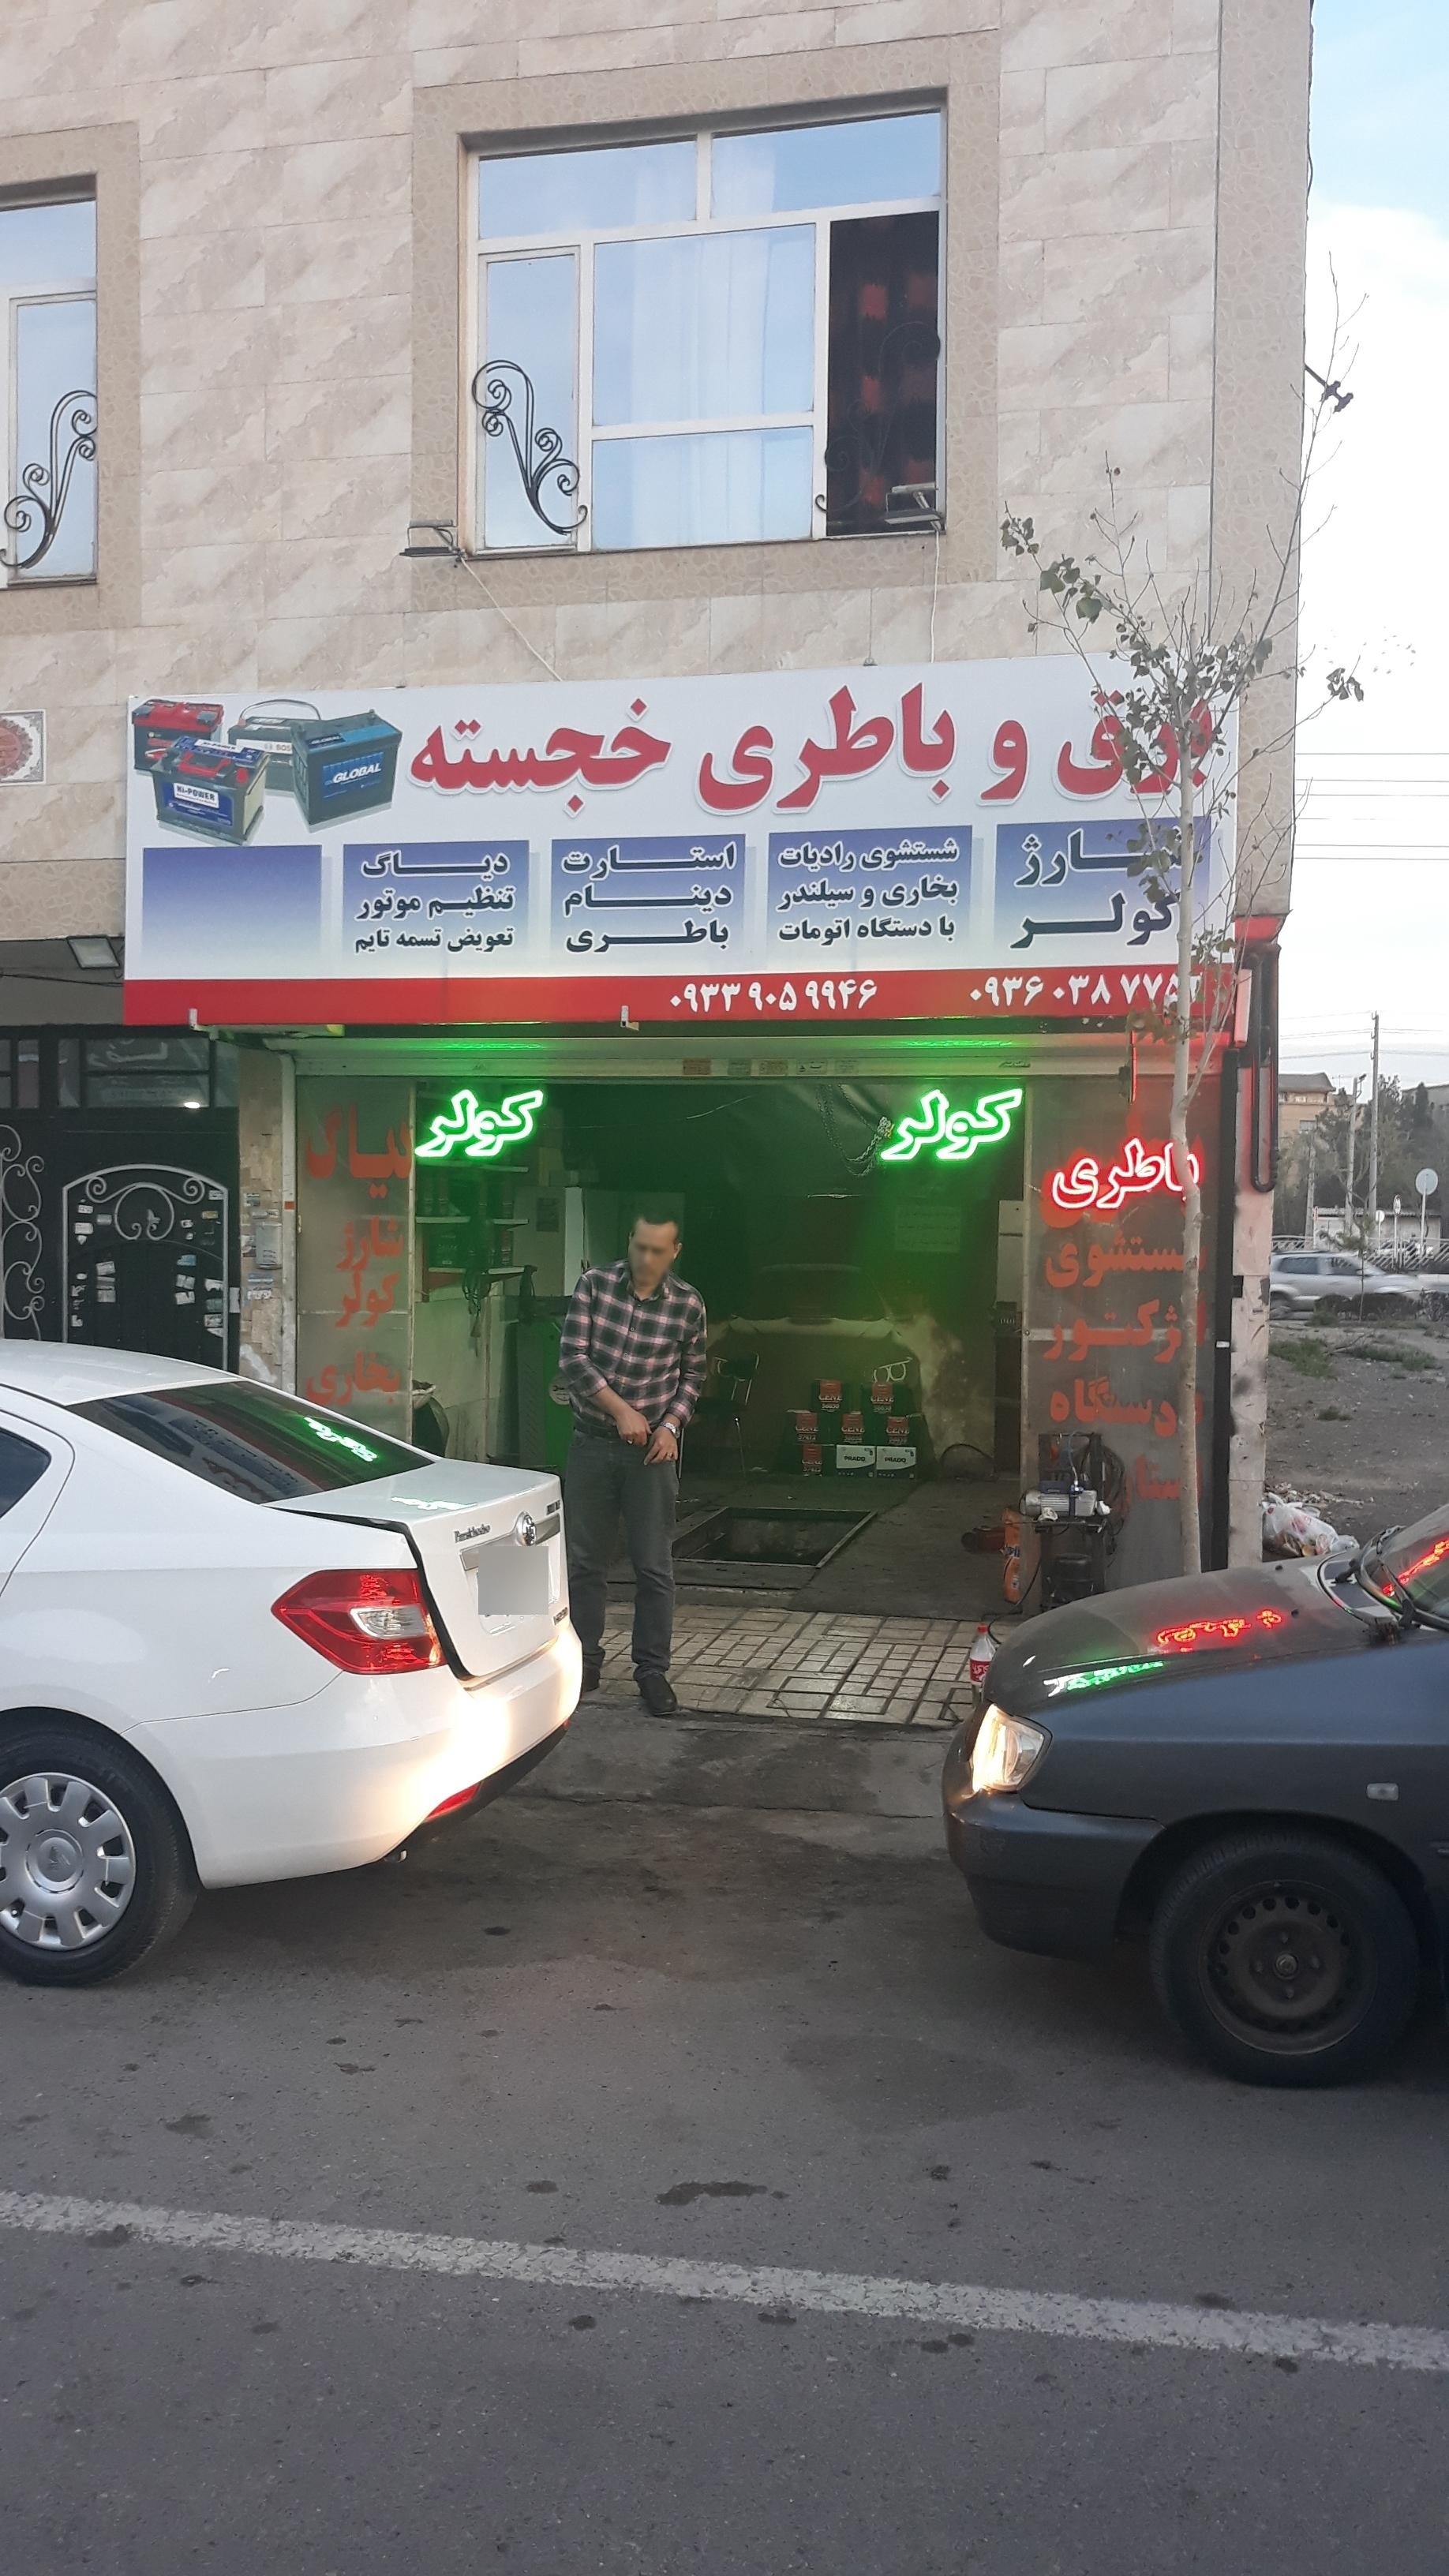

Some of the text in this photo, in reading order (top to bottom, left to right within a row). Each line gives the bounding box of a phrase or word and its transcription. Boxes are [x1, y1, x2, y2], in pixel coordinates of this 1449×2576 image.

[333, 762, 382, 784] GLOBAL
[410, 698, 672, 814] خجسته
[698, 681, 957, 811] باطری
[980, 719, 1027, 801] و
[362, 852, 508, 880] دیاگ
[563, 844, 735, 879] استارت
[779, 839, 958, 871] شستشوی رادیات
[356, 886, 515, 919] تنظیم موتور
[564, 885, 732, 916] دینام
[777, 876, 958, 910] بخاری و سیلندر
[355, 928, 514, 953] تعویض تسمه تایم
[566, 919, 729, 953] باطری
[778, 915, 955, 946] با دستگاه اتومات
[414, 1088, 545, 1158] کولر
[879, 1088, 1024, 1161] کولر
[1051, 1137, 1200, 1209] باطری
[1046, 1228, 1207, 1288] ستشوی
[335, 1268, 401, 1328] کولر
[1043, 1290, 1207, 1364] اژکتور
[305, 1350, 401, 1407] بخاری
[1050, 1376, 1178, 1440] دستگاه
